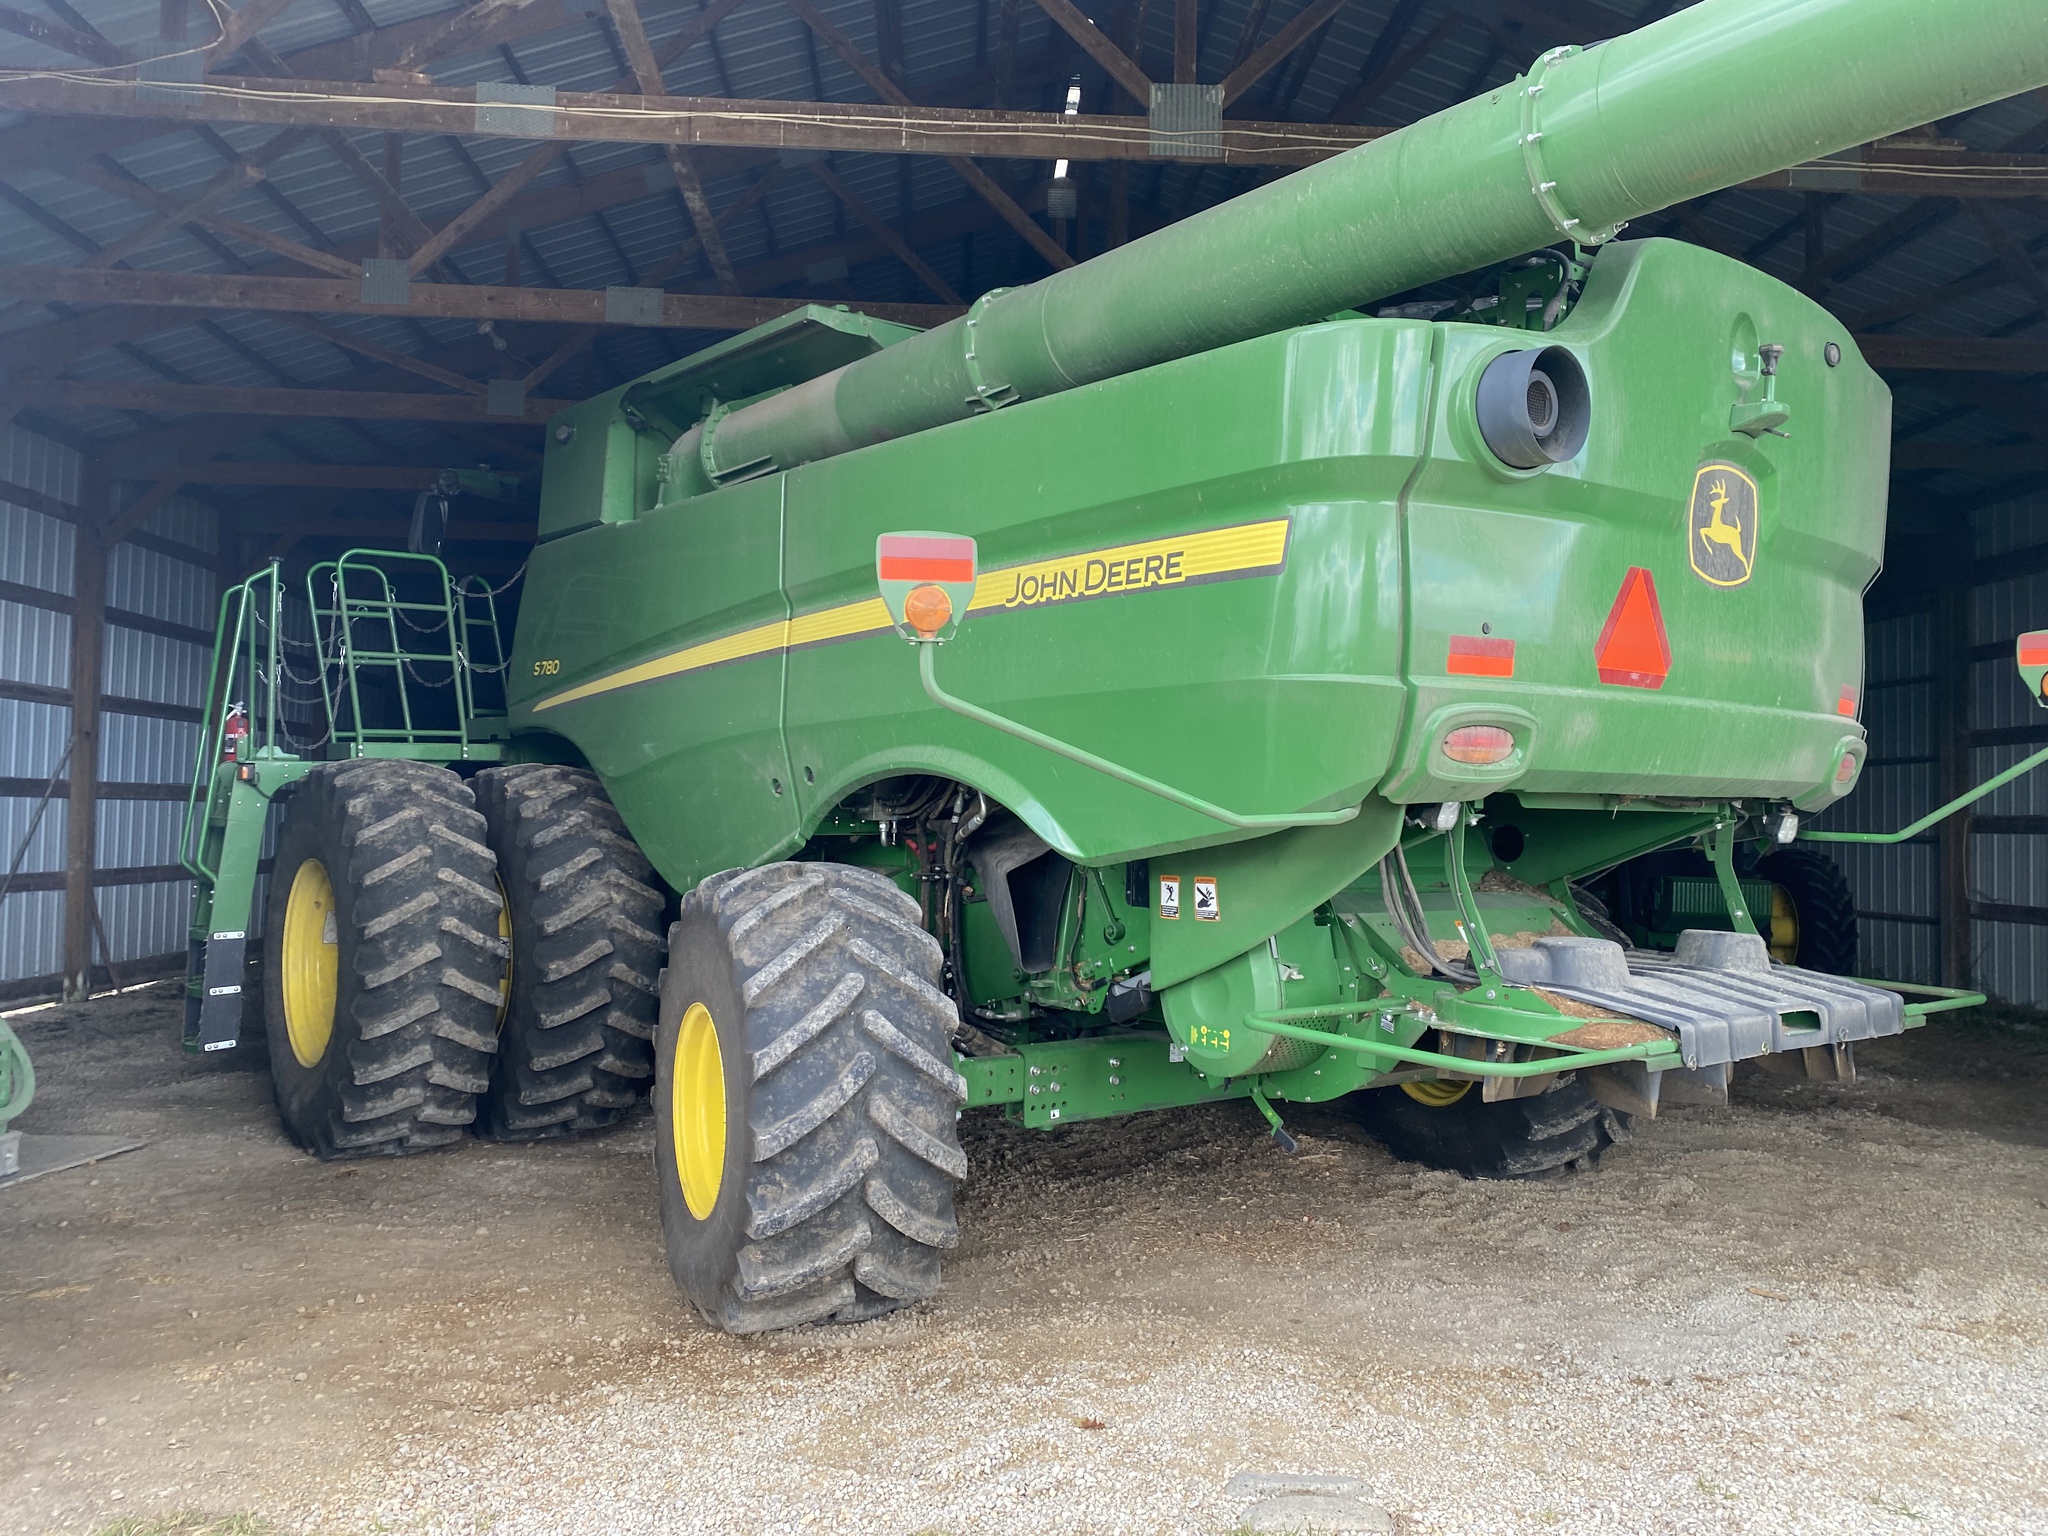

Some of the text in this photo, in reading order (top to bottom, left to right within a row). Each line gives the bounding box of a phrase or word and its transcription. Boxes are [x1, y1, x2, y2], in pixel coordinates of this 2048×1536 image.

[1005, 551, 1185, 604] JOHN DEERE
[533, 659, 560, 676] S780
